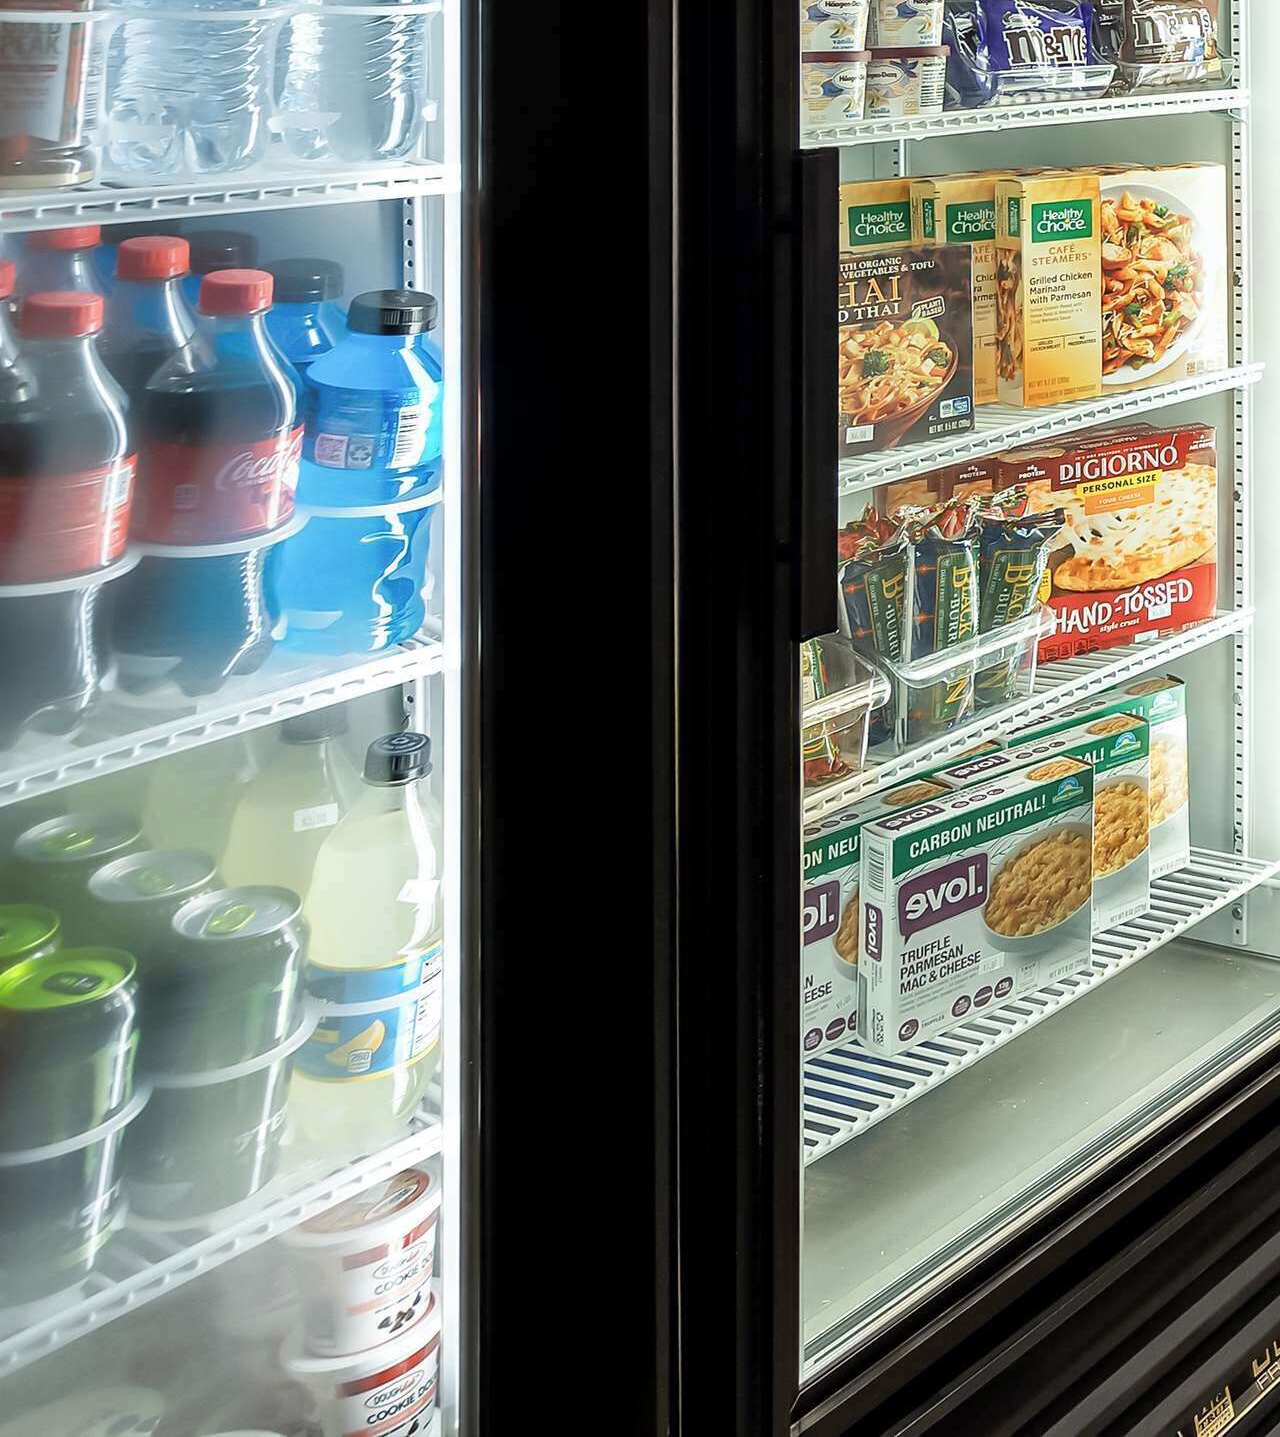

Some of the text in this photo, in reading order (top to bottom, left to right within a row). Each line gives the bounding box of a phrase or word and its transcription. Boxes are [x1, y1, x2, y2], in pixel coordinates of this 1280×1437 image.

[860, 210, 904, 224] Healthy
[1042, 208, 1084, 222] Healthy
[854, 220, 906, 237] Choice
[1036, 218, 1087, 235] Choice
[1048, 243, 1076, 255] CAFÉ
[842, 260, 935, 280] VEGETABLES & TOFU
[859, 256, 902, 270] ORGANIC
[1029, 271, 1093, 286] Grilled Chicken
[1029, 284, 1066, 295] Marinara
[1029, 290, 1092, 305] with Parmesan
[856, 302, 900, 320] THAI
[920, 299, 942, 310] PLANT
[921, 306, 944, 318] BASED
[959, 469, 987, 480] PROTEIN
[1018, 469, 1046, 480] PROTEIN
[1081, 473, 1158, 494] PERSONAL SIZE
[1098, 491, 1142, 505] FOUR CHEESE
[1099, 616, 1140, 634] style crust
[886, 805, 941, 828] evol.
[908, 793, 1047, 859] CARBON NEUTRAL!
[904, 864, 984, 921] evol.
[866, 906, 879, 955] evol.
[900, 935, 951, 966] TRUFFLE
[899, 943, 964, 980] PARMESAN
[899, 950, 982, 995] MAC & CHEESE
[375, 1266, 418, 1296] COOKIE
[366, 1392, 416, 1425] COOKIE
